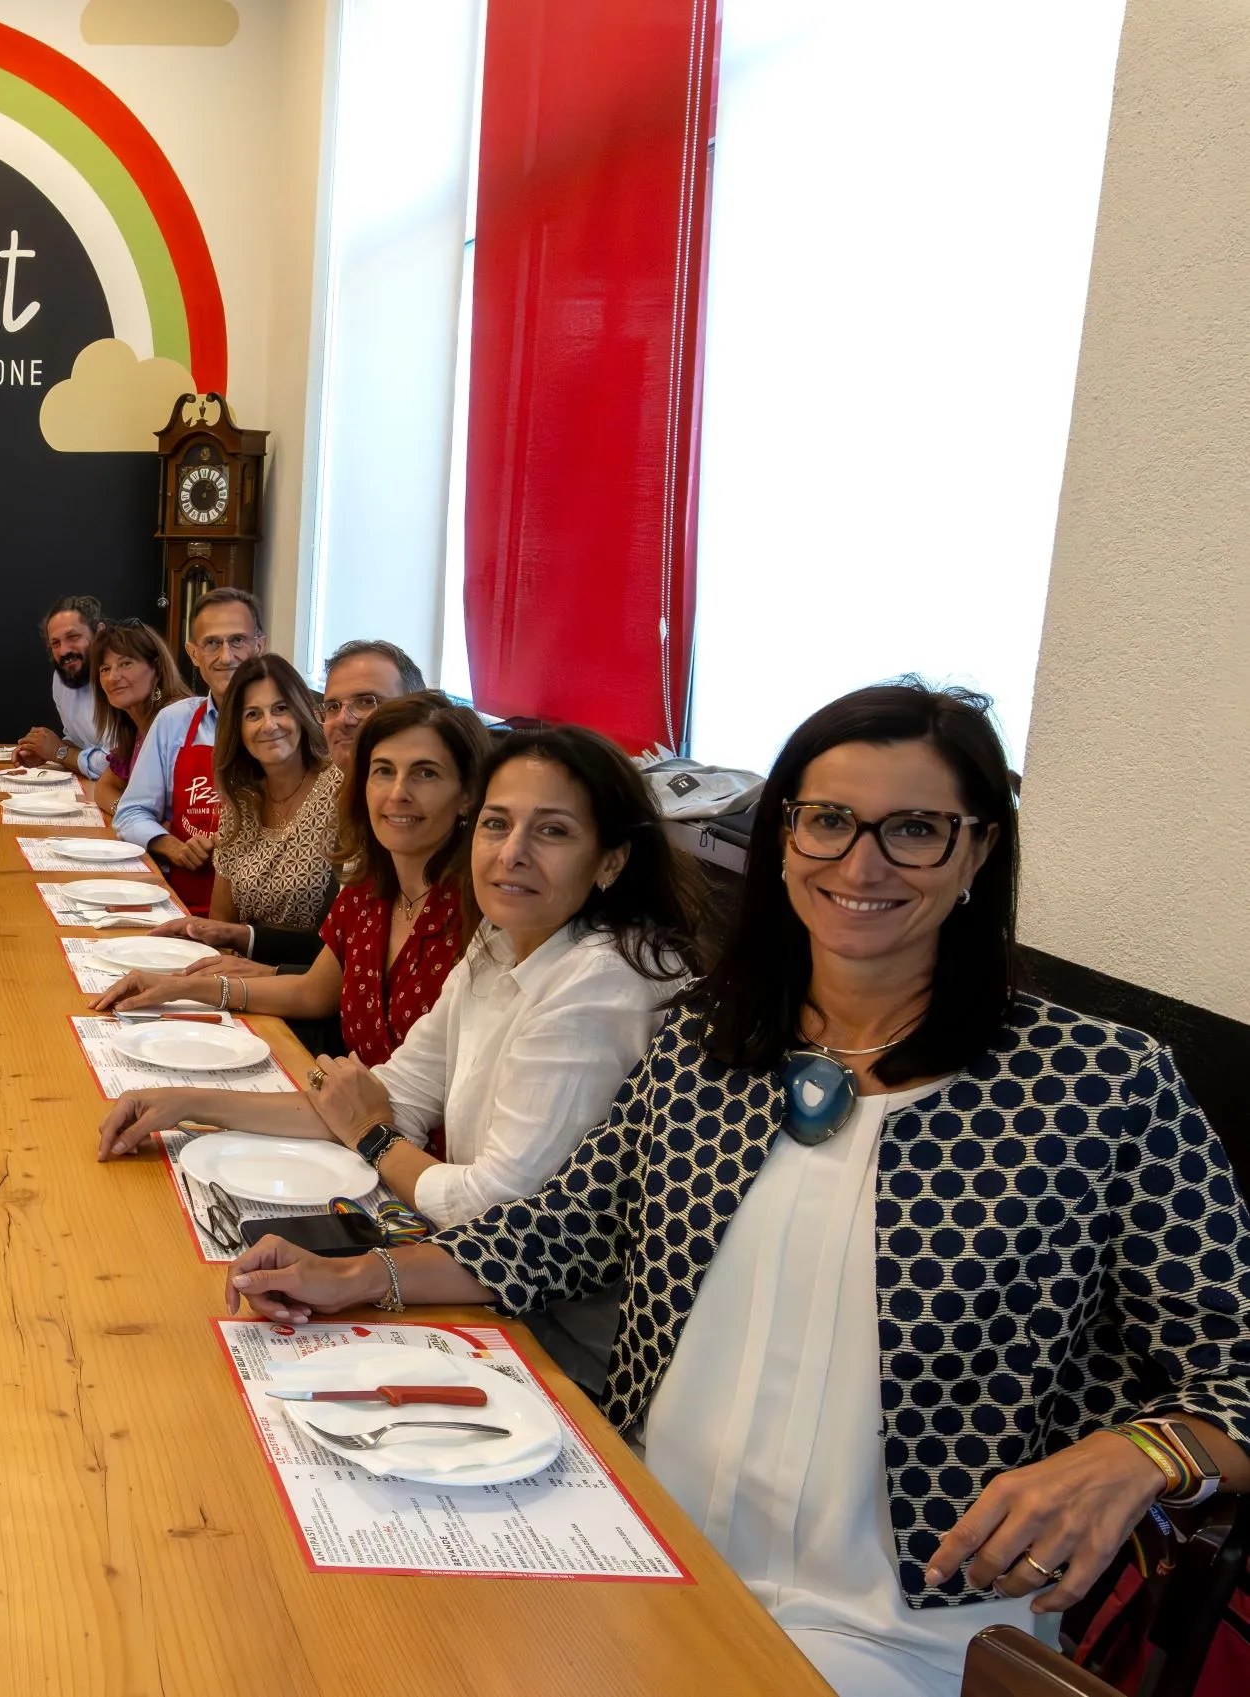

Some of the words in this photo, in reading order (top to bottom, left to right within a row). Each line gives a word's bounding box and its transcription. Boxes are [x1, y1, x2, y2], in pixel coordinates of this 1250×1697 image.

[185, 776, 221, 806] Pizz
[260, 1417, 271, 1431] PIZZE
[266, 1433, 280, 1455] NOSTRE
[304, 1526, 326, 1561] ANTIPASTI
[440, 1537, 462, 1566] BEVANDE
